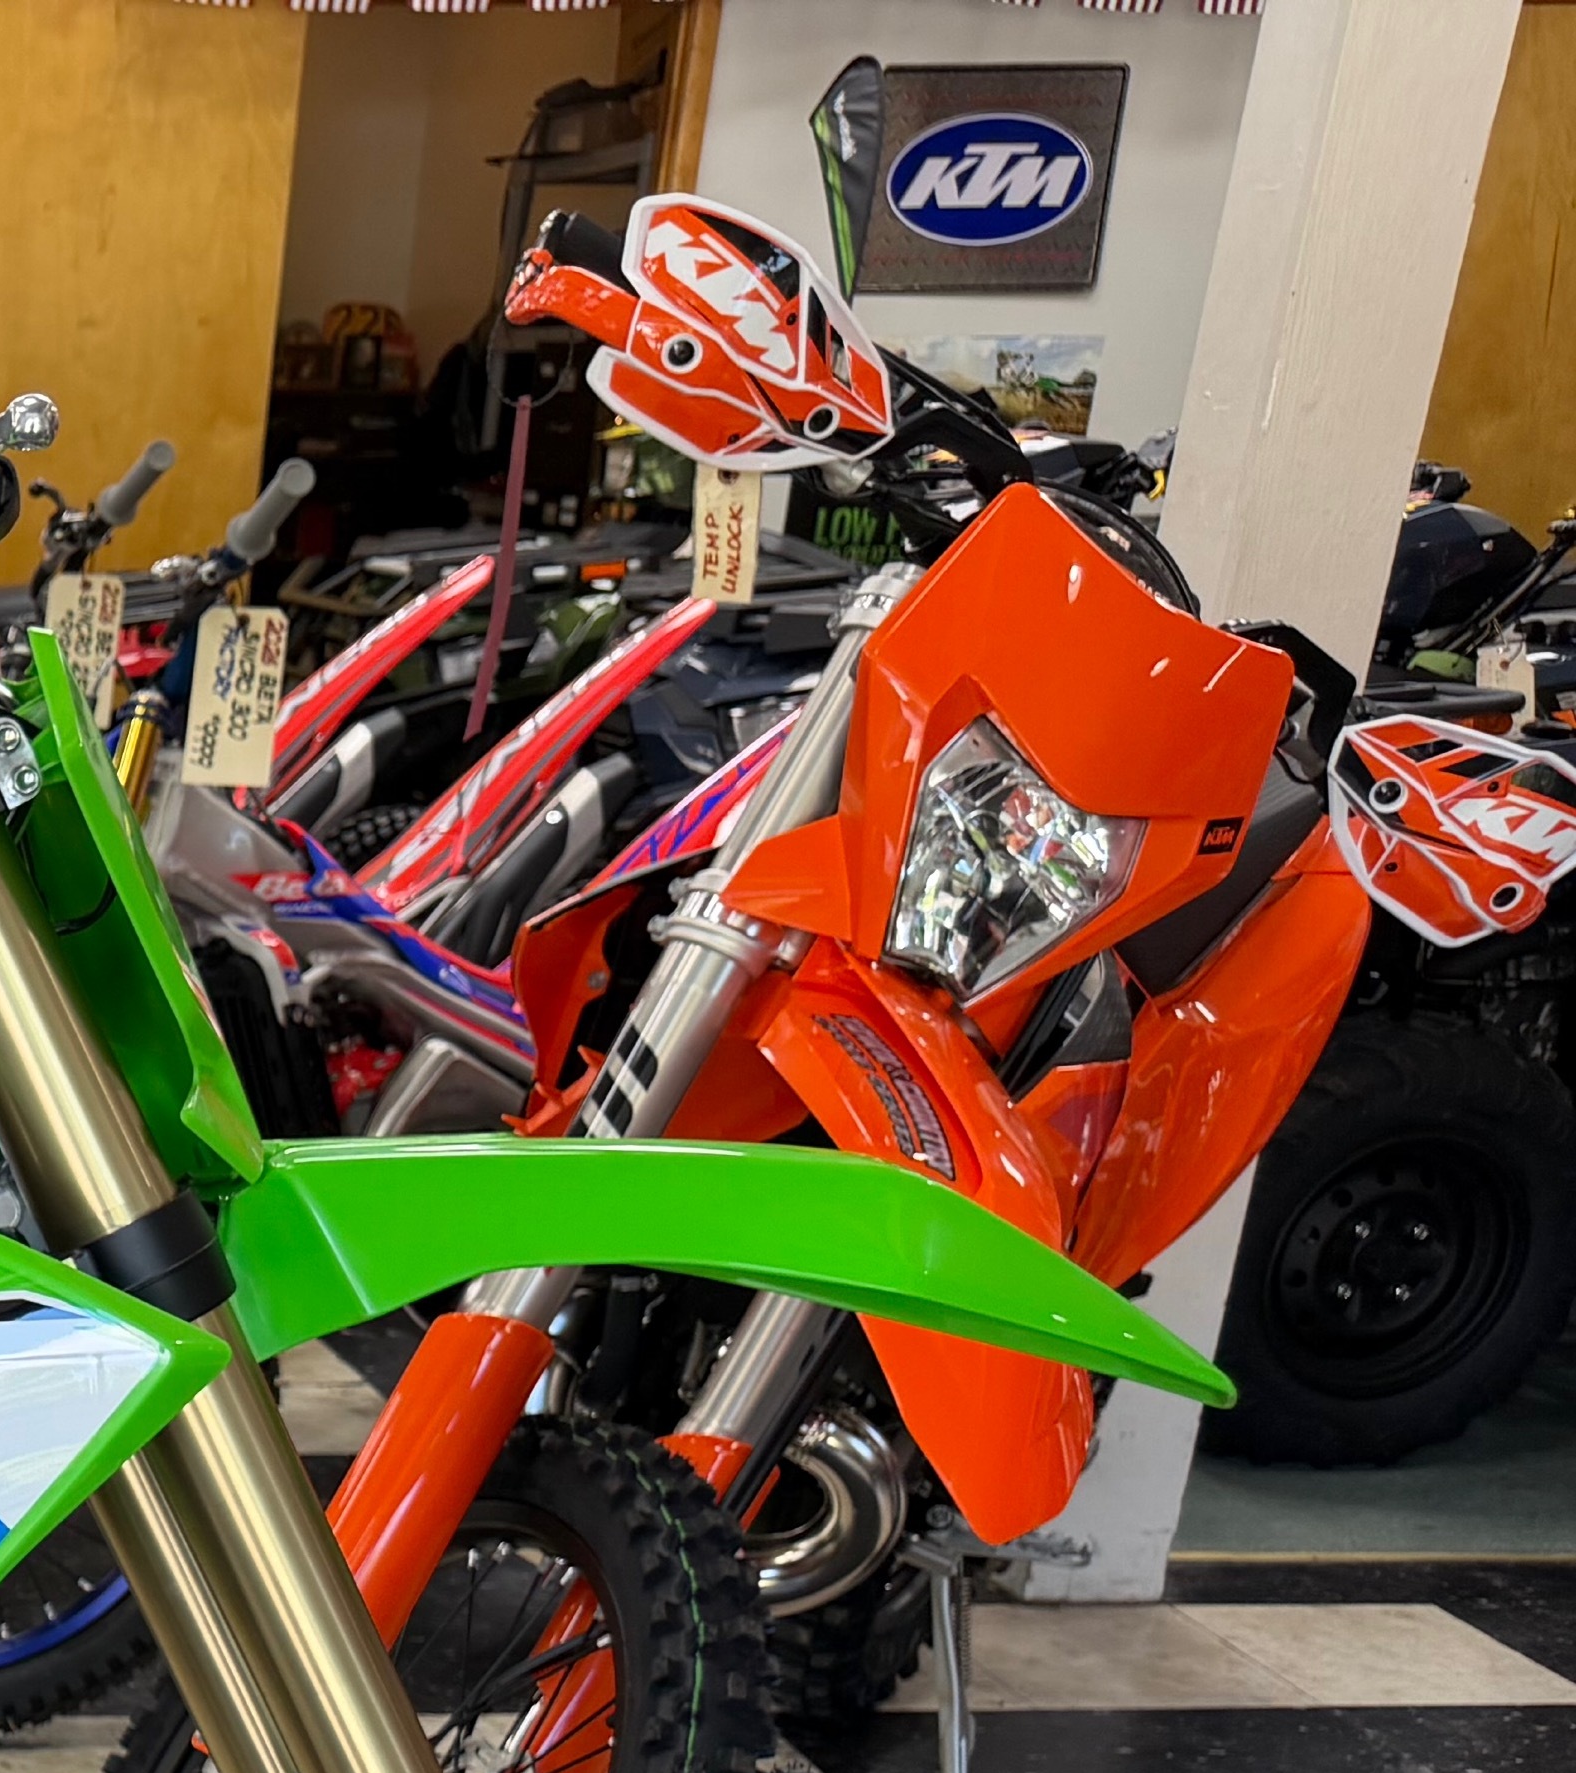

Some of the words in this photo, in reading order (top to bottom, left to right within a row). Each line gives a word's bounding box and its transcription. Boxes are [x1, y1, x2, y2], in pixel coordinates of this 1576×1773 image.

[898, 142, 1082, 210] KTM
[644, 220, 797, 373] KTM
[702, 511, 721, 581] TEMP
[721, 504, 745, 594] UNLOCK
[813, 506, 878, 549] LOW
[235, 629, 260, 696] SINCRO
[228, 699, 251, 742] 300
[255, 672, 278, 726] BETA
[1202, 826, 1236, 847] KTM
